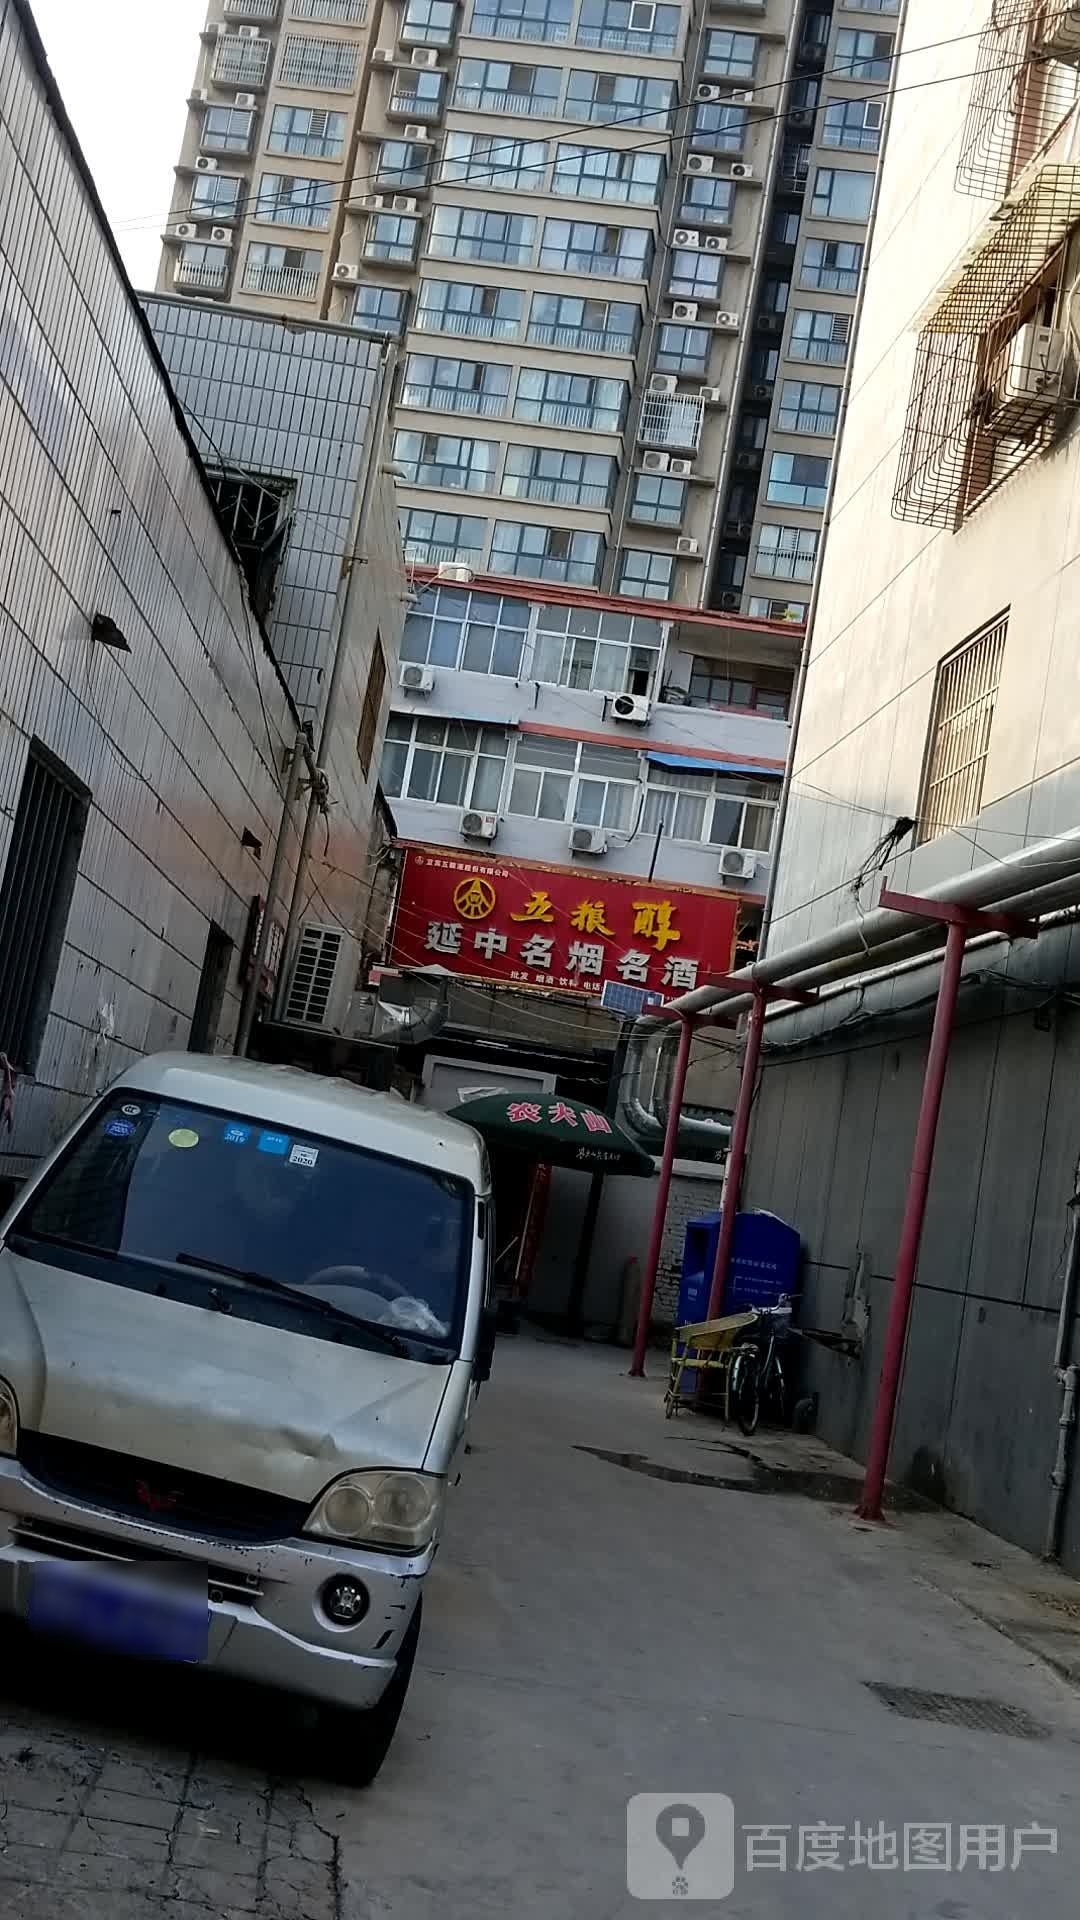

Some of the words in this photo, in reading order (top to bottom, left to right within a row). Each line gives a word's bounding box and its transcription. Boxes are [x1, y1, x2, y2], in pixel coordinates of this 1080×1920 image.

[510, 890, 681, 952] 五粮醇
[424, 921, 699, 990] 延中名烟名酒
[510, 970, 529, 980] 批发
[559, 977, 579, 988] 饮料
[583, 981, 601, 991] 电话
[293, 1155, 313, 1166] 2020
